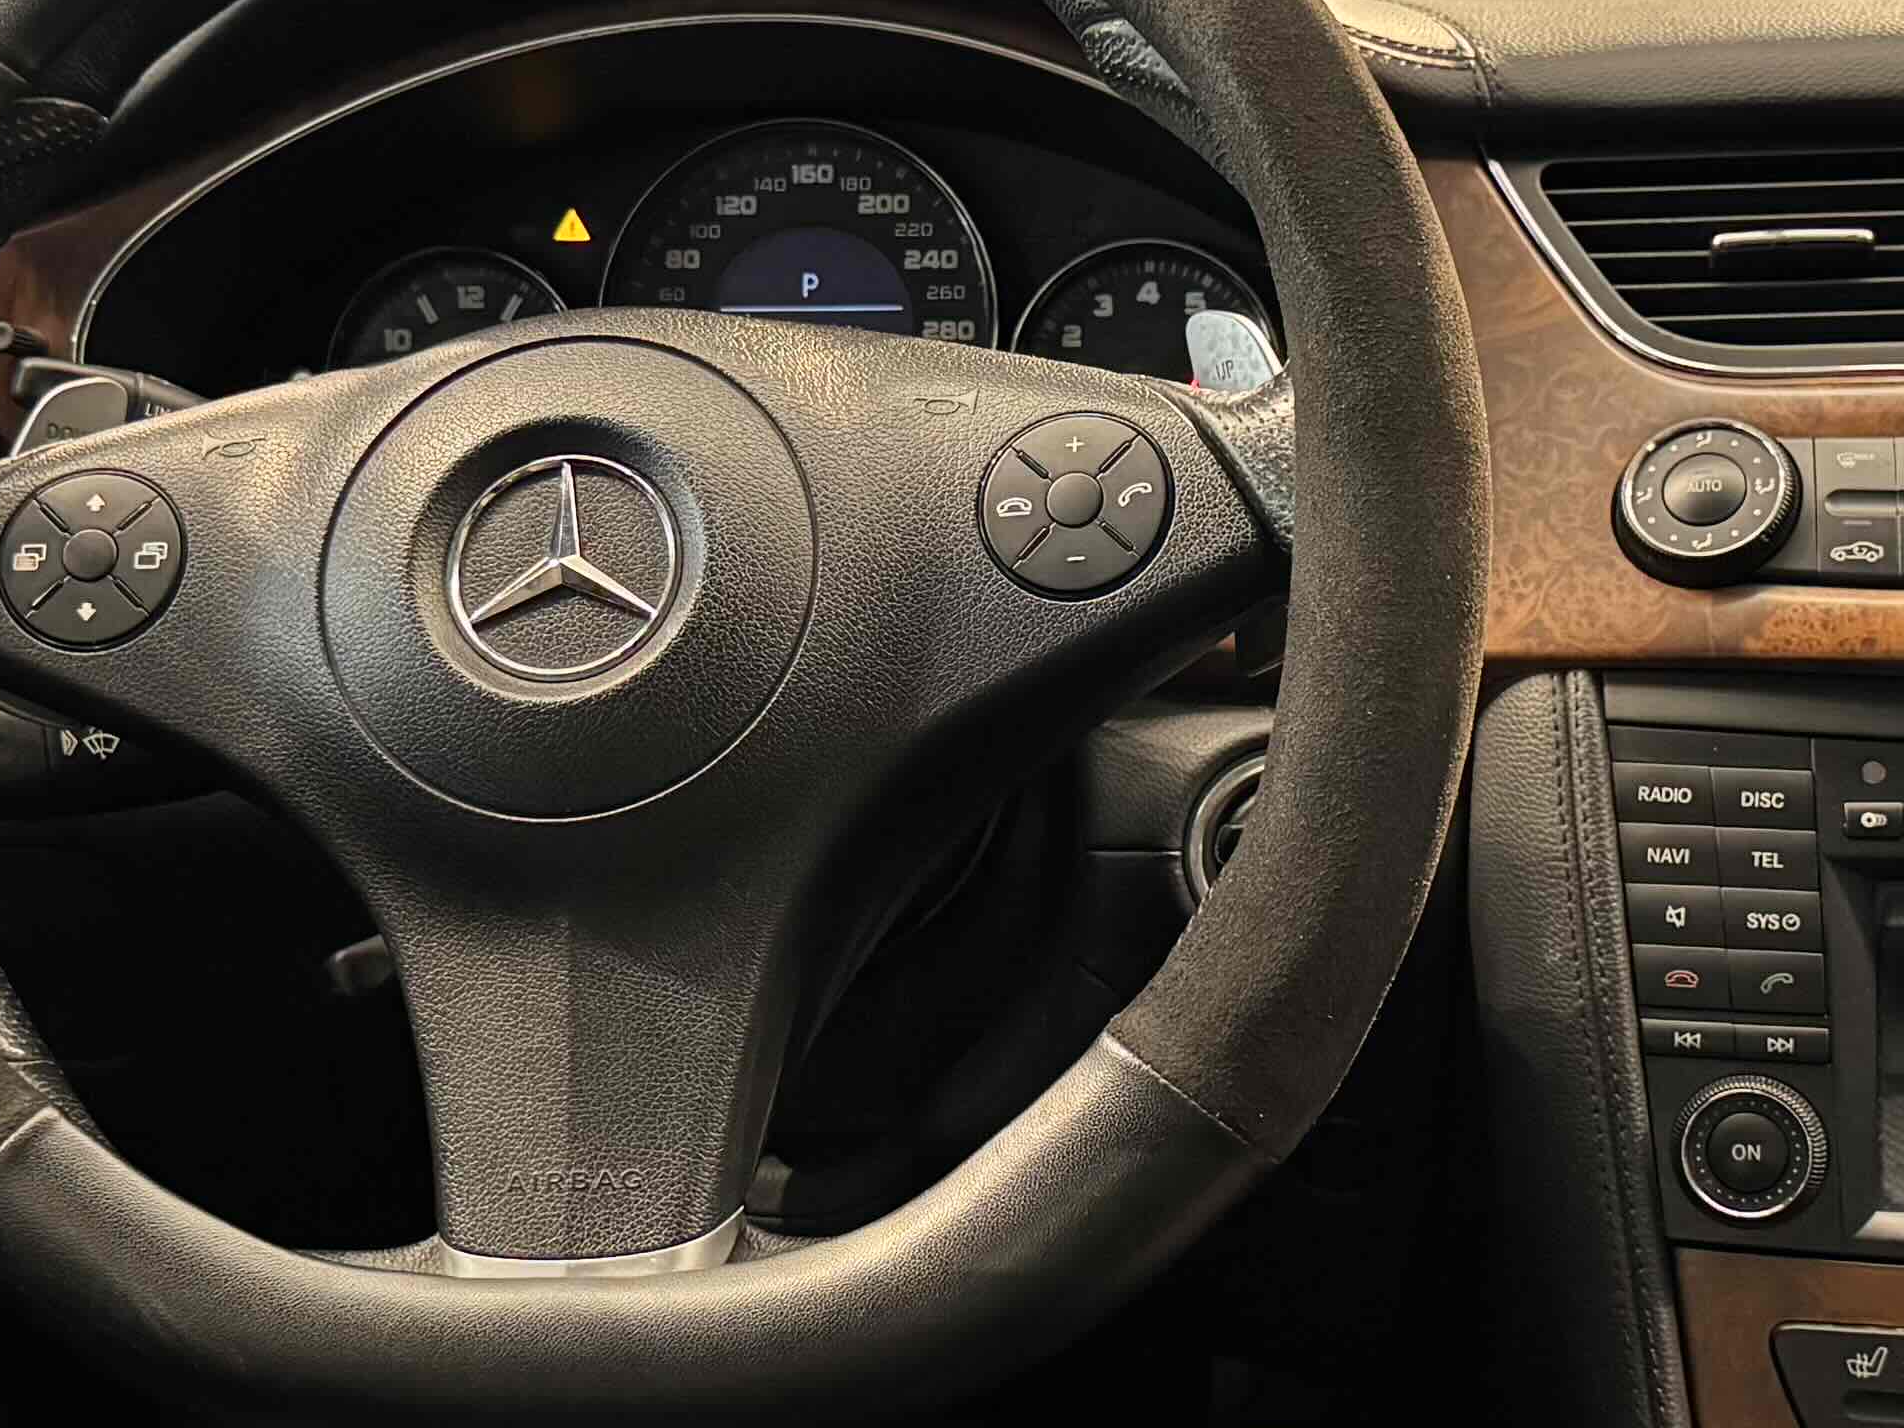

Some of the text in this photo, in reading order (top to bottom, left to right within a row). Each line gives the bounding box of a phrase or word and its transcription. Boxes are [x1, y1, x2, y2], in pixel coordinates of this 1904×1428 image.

[791, 164, 835, 184] 160
[840, 177, 871, 191] 180
[754, 178, 787, 192] 140
[715, 195, 757, 216] 120
[857, 194, 910, 215] 200
[690, 224, 721, 239] 100
[895, 222, 934, 237] 220
[665, 249, 701, 270] 80
[903, 250, 958, 270] 240
[802, 272, 820, 298] P
[926, 285, 966, 301] 260
[1136, 281, 1161, 305] 4
[456, 285, 485, 309] 12
[1093, 294, 1114, 317] 3
[1184, 291, 1206, 316] 5
[384, 329, 412, 352] 10
[922, 320, 976, 341] 280
[1061, 324, 1082, 348] 2
[1216, 360, 1235, 381] UP
[1687, 478, 1723, 494] AUTO
[1637, 785, 1693, 804] RADIO
[1740, 791, 1785, 809] DISC
[1647, 846, 1690, 864] NAVI
[1751, 851, 1784, 869] TEL
[1746, 912, 1780, 931] SYS
[1731, 1143, 1762, 1161] ON
[507, 1170, 643, 1193] AIRBAG
